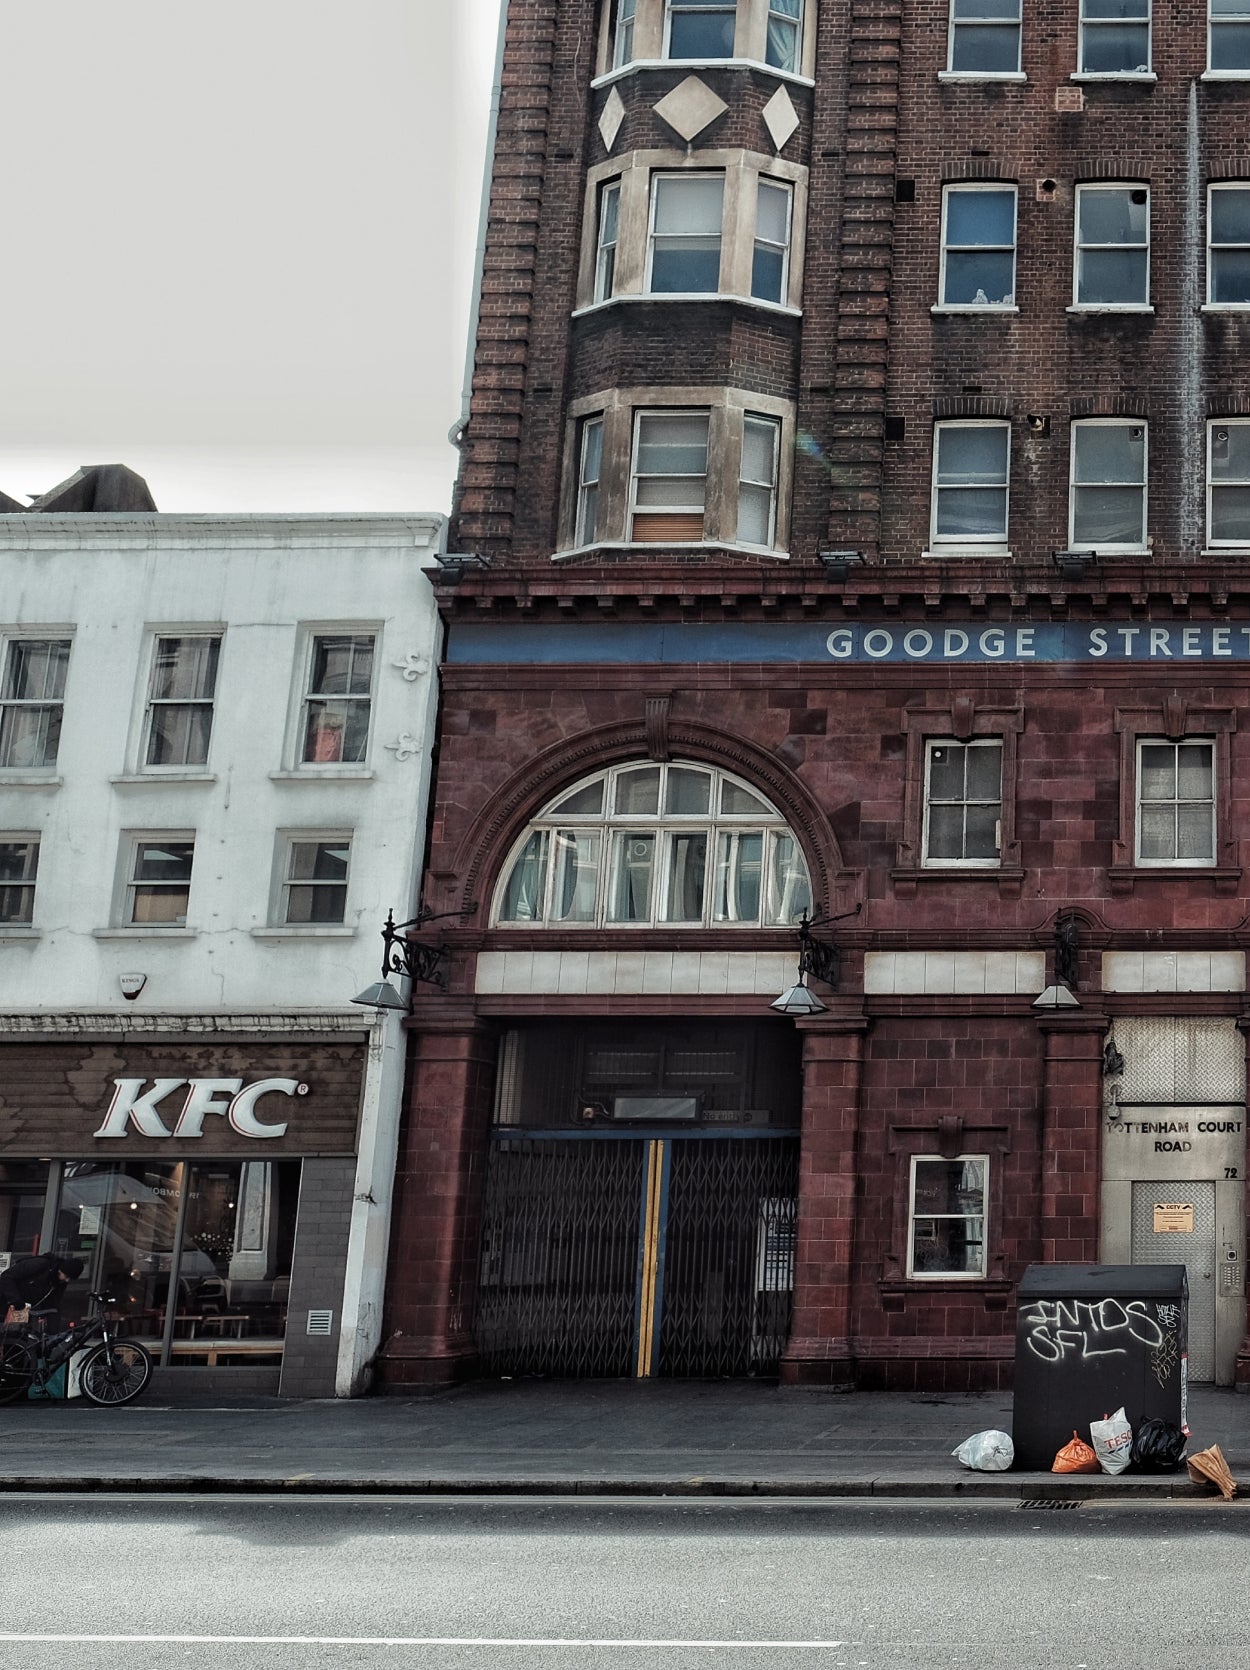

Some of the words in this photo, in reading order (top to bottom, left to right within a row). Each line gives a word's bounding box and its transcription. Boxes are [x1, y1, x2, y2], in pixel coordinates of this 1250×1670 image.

[826, 628, 1036, 658] GOODGE
[93, 1078, 299, 1138] KFC
[1197, 1121, 1243, 1133] COURT
[1154, 1141, 1192, 1152] ROAD
[1224, 1168, 1238, 1178] 72
